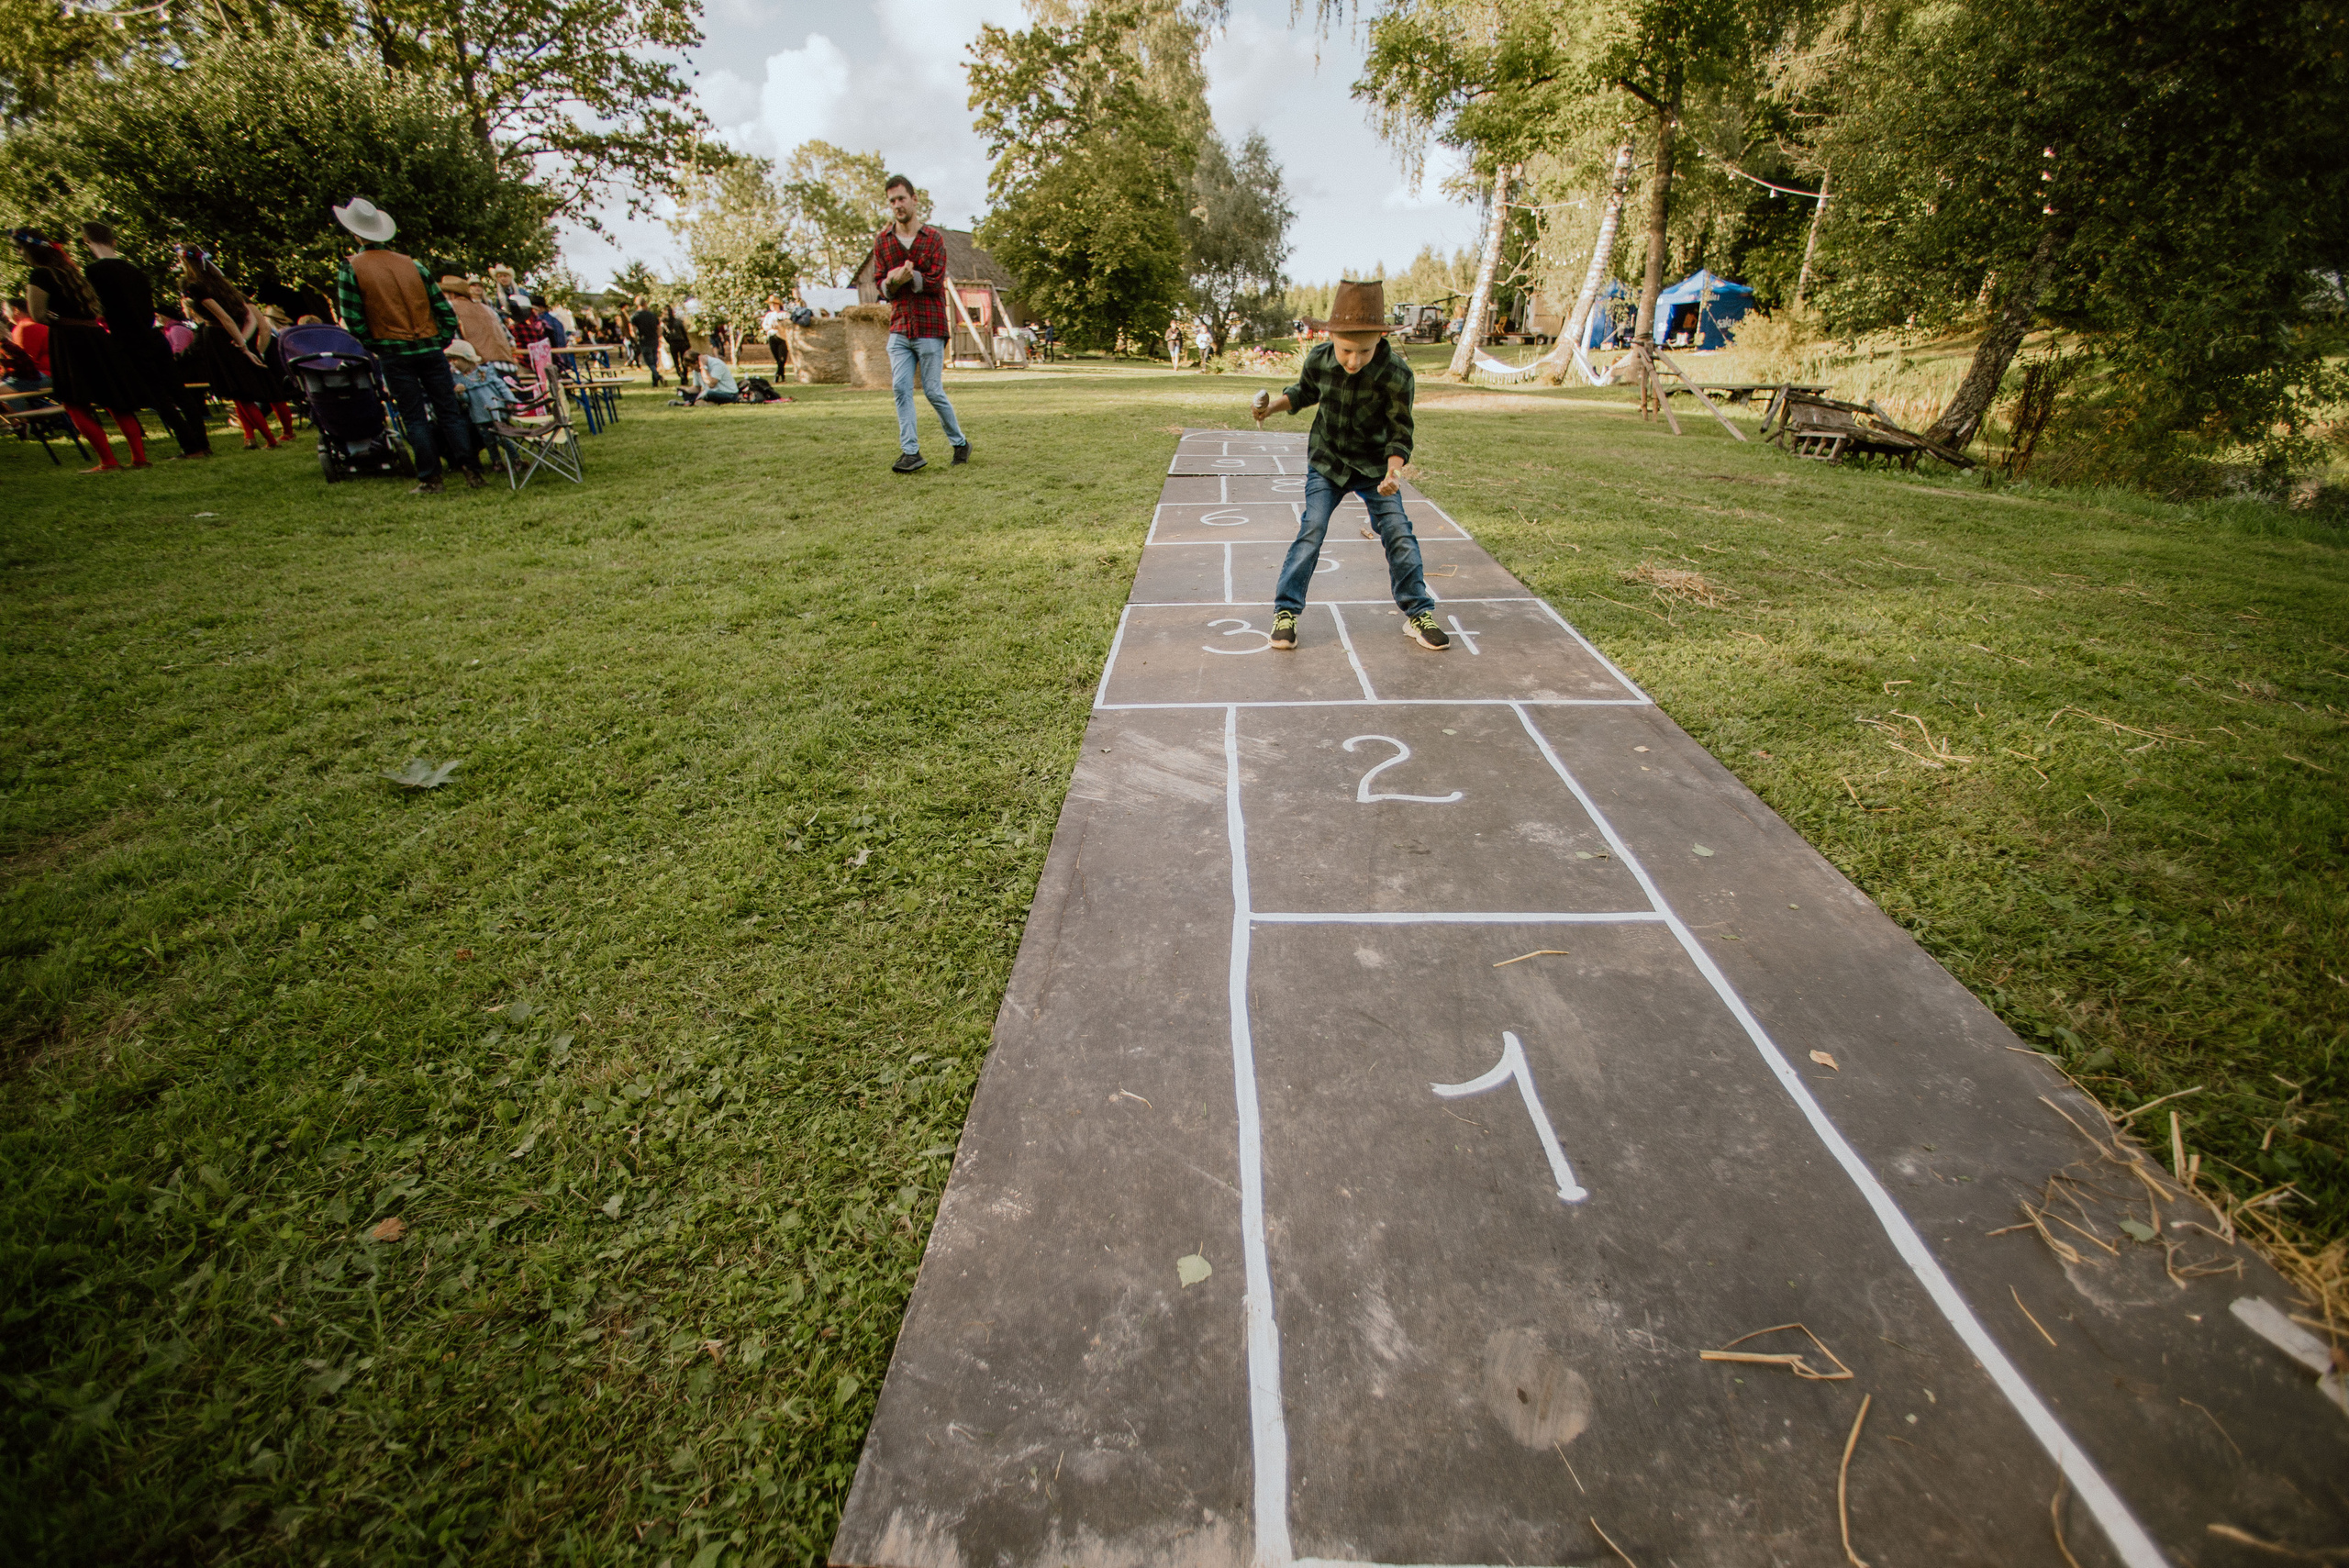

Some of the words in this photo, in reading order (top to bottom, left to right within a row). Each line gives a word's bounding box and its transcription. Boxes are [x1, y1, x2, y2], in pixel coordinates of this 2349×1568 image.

[1210, 459, 1247, 468] 9
[1271, 478, 1307, 493] 8
[1199, 508, 1250, 527] 6
[1202, 618, 1272, 655] 3
[1342, 734, 1464, 803] 2
[1429, 1030, 1588, 1201] 1
